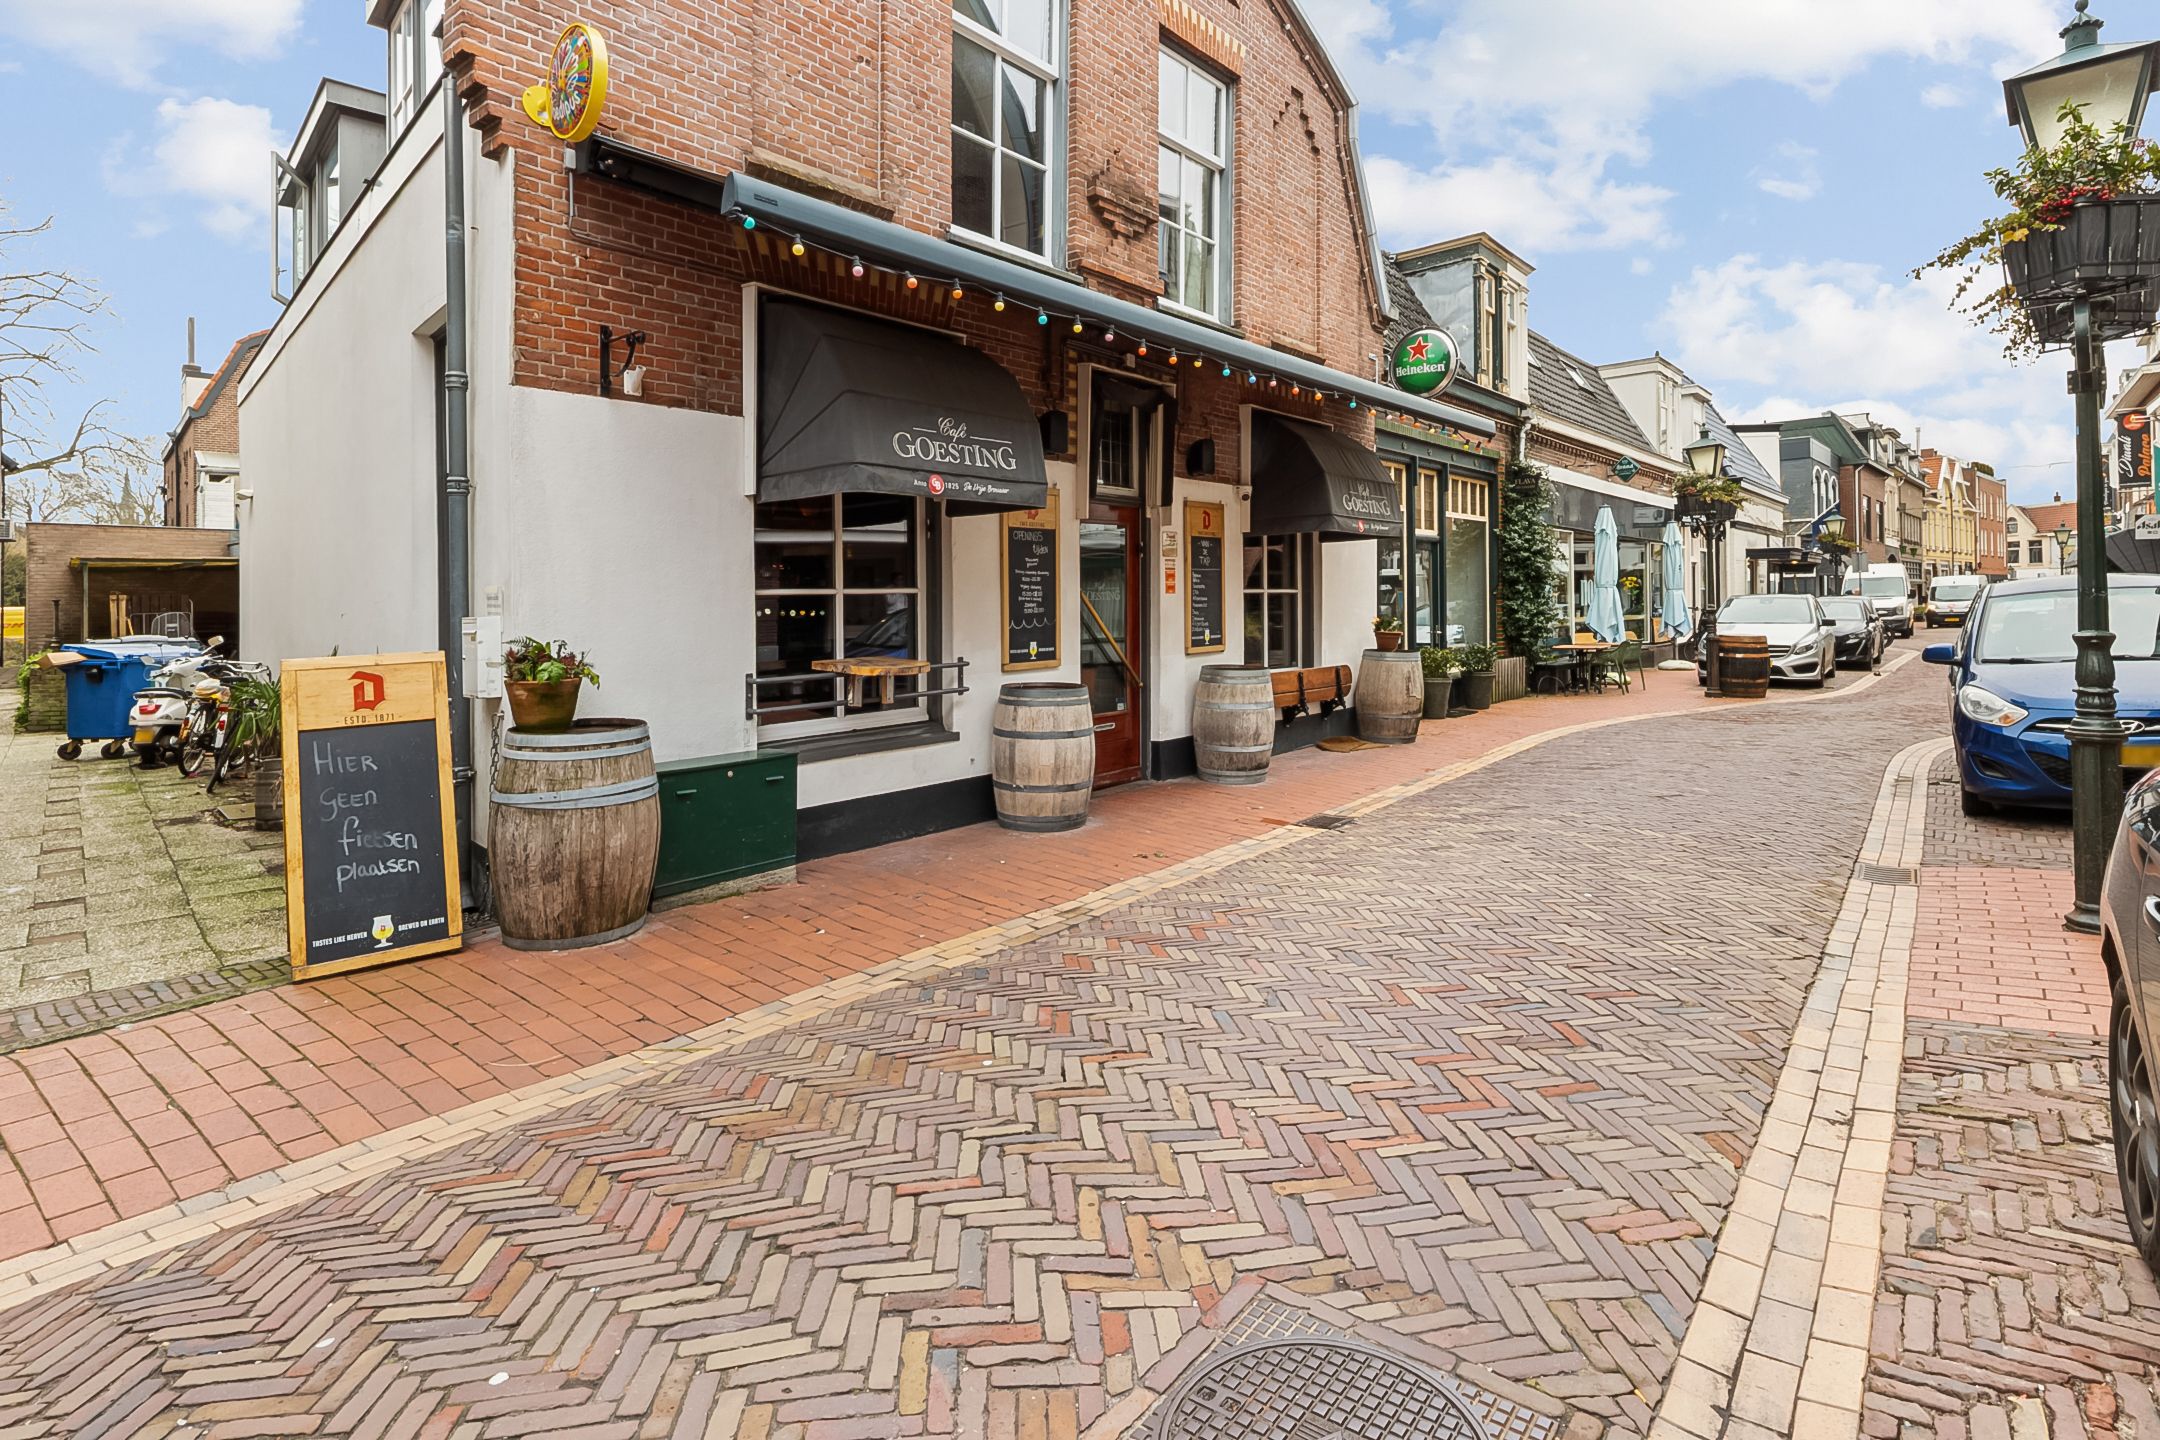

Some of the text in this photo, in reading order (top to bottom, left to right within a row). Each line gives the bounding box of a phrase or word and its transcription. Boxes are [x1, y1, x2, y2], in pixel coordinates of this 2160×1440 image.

[1396, 362, 1446, 377] Heineken
[938, 417, 967, 442] Café
[893, 431, 1017, 470] GOESTING
[1342, 494, 1391, 516] GOESTING
[2136, 520, 2160, 530] Asa
[375, 713, 395, 723] 1871
[398, 921, 420, 931] BREWED
[428, 916, 445, 926] EARTH
[312, 931, 368, 948] TASTES LIKE HEAVEN
